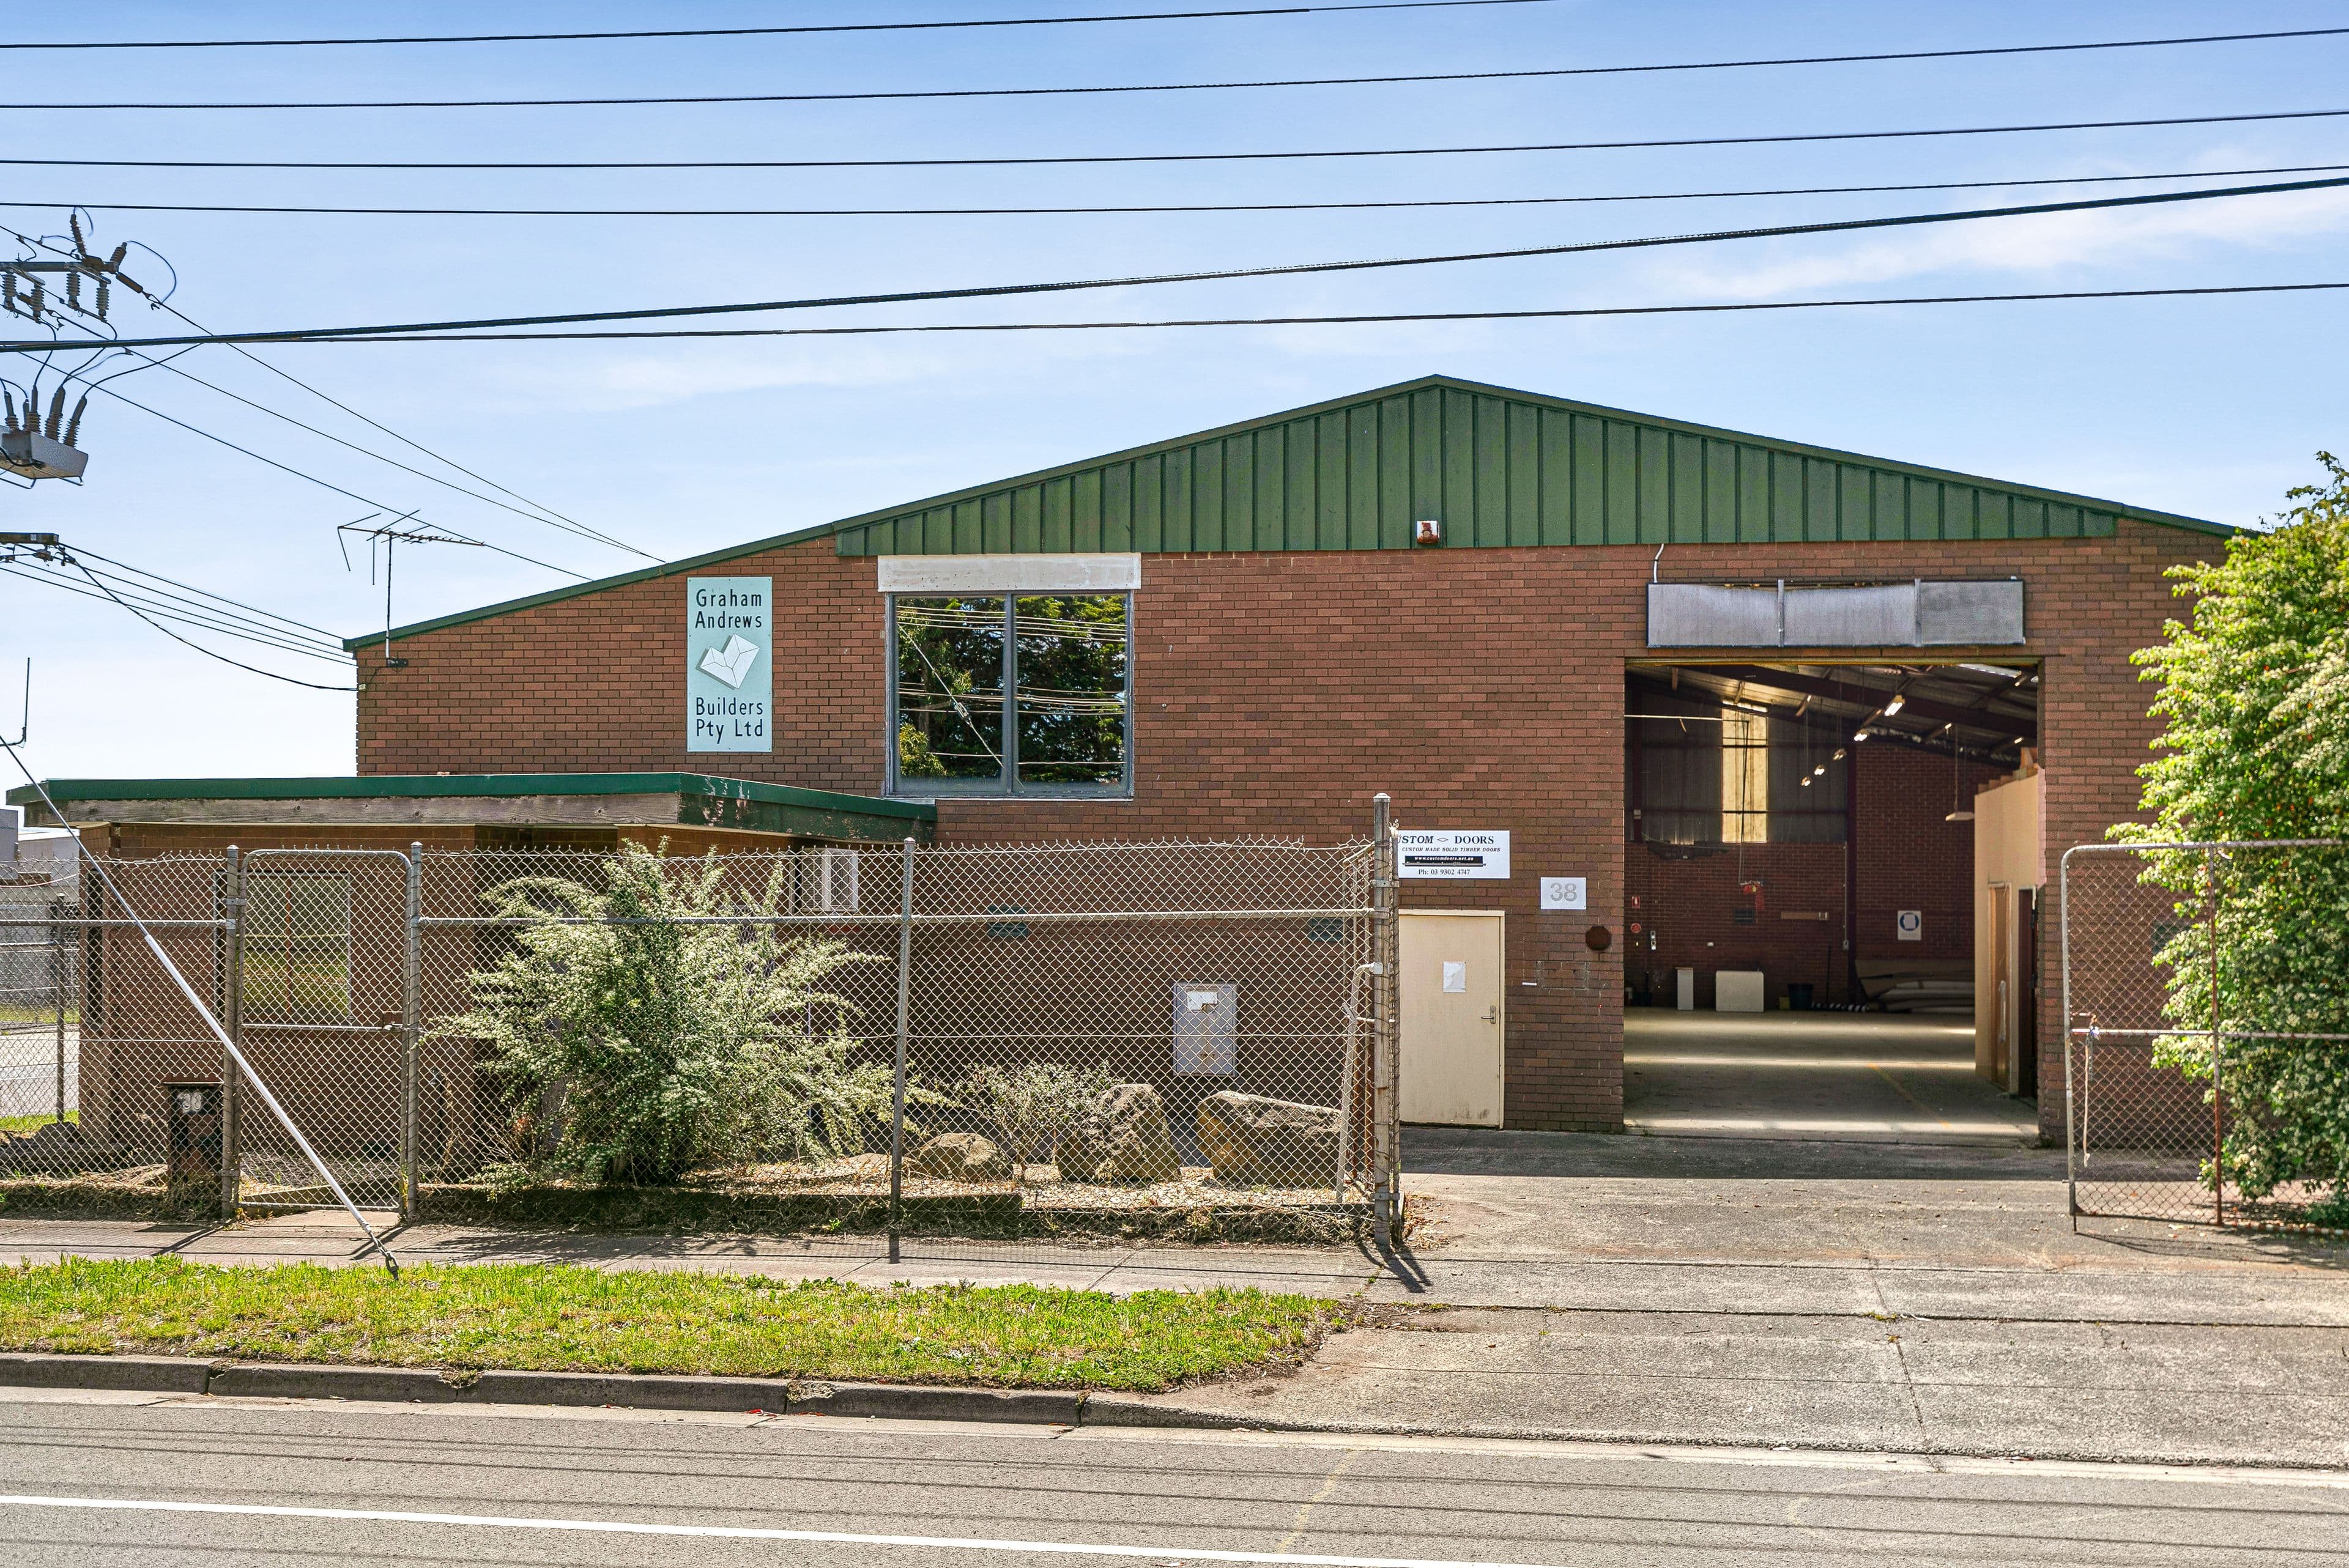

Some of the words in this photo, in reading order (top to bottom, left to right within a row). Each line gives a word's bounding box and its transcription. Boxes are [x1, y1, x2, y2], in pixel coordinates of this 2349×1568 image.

[696, 588, 762, 607] Graham
[695, 611, 762, 629] Andrews
[696, 697, 763, 716] Builders
[696, 719, 724, 744] Pty
[735, 719, 763, 737] Ltd
[1397, 835, 1434, 844] USTOM
[1455, 835, 1494, 844] DOORS
[1550, 882, 1577, 901] 38
